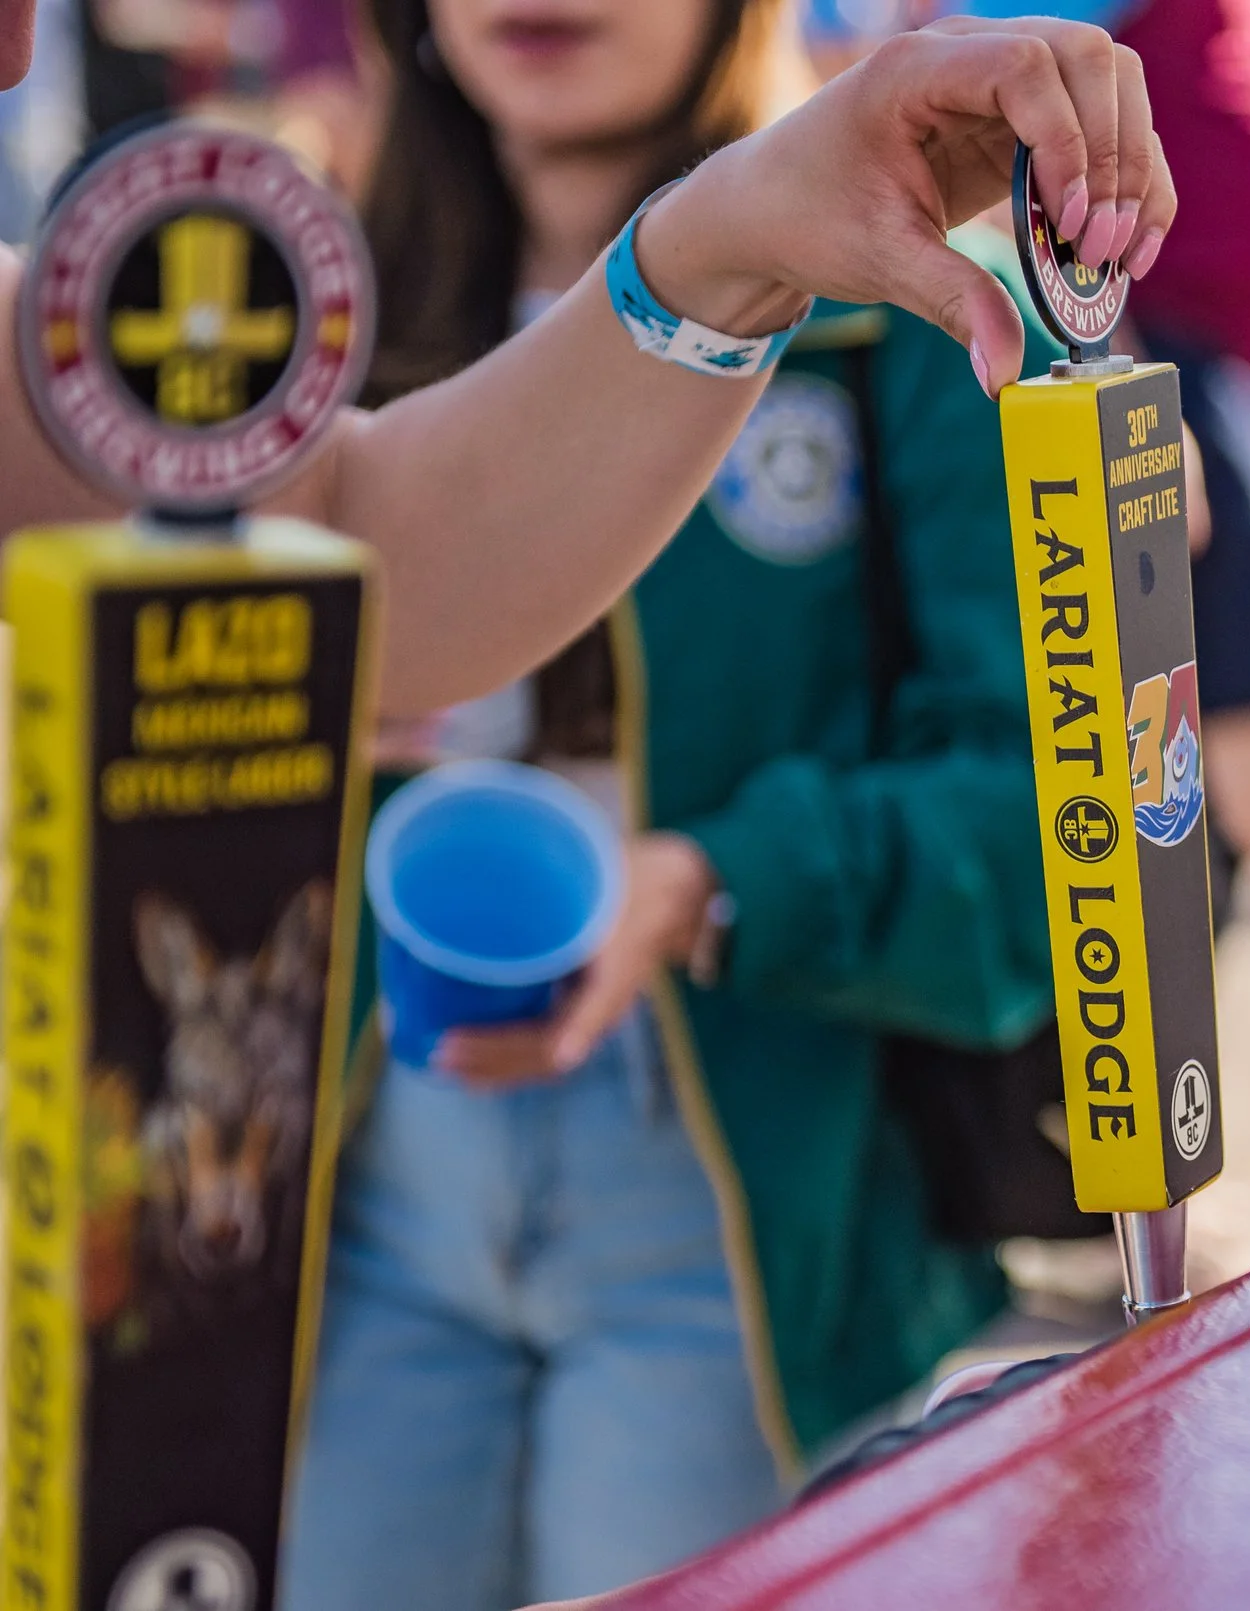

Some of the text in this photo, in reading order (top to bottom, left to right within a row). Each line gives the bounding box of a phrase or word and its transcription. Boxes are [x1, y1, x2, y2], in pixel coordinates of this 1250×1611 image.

[1042, 257, 1116, 331] BREWING
[1127, 404, 1158, 447] 30TH
[1110, 442, 1181, 488] ANNIVERSARY
[1118, 487, 1179, 532] CRAFT LITE
[137, 597, 309, 690] LAZO
[1030, 477, 1137, 1143] LARIAT LODGE
[1063, 819, 1078, 840] BC
[1186, 1122, 1199, 1146] BC
